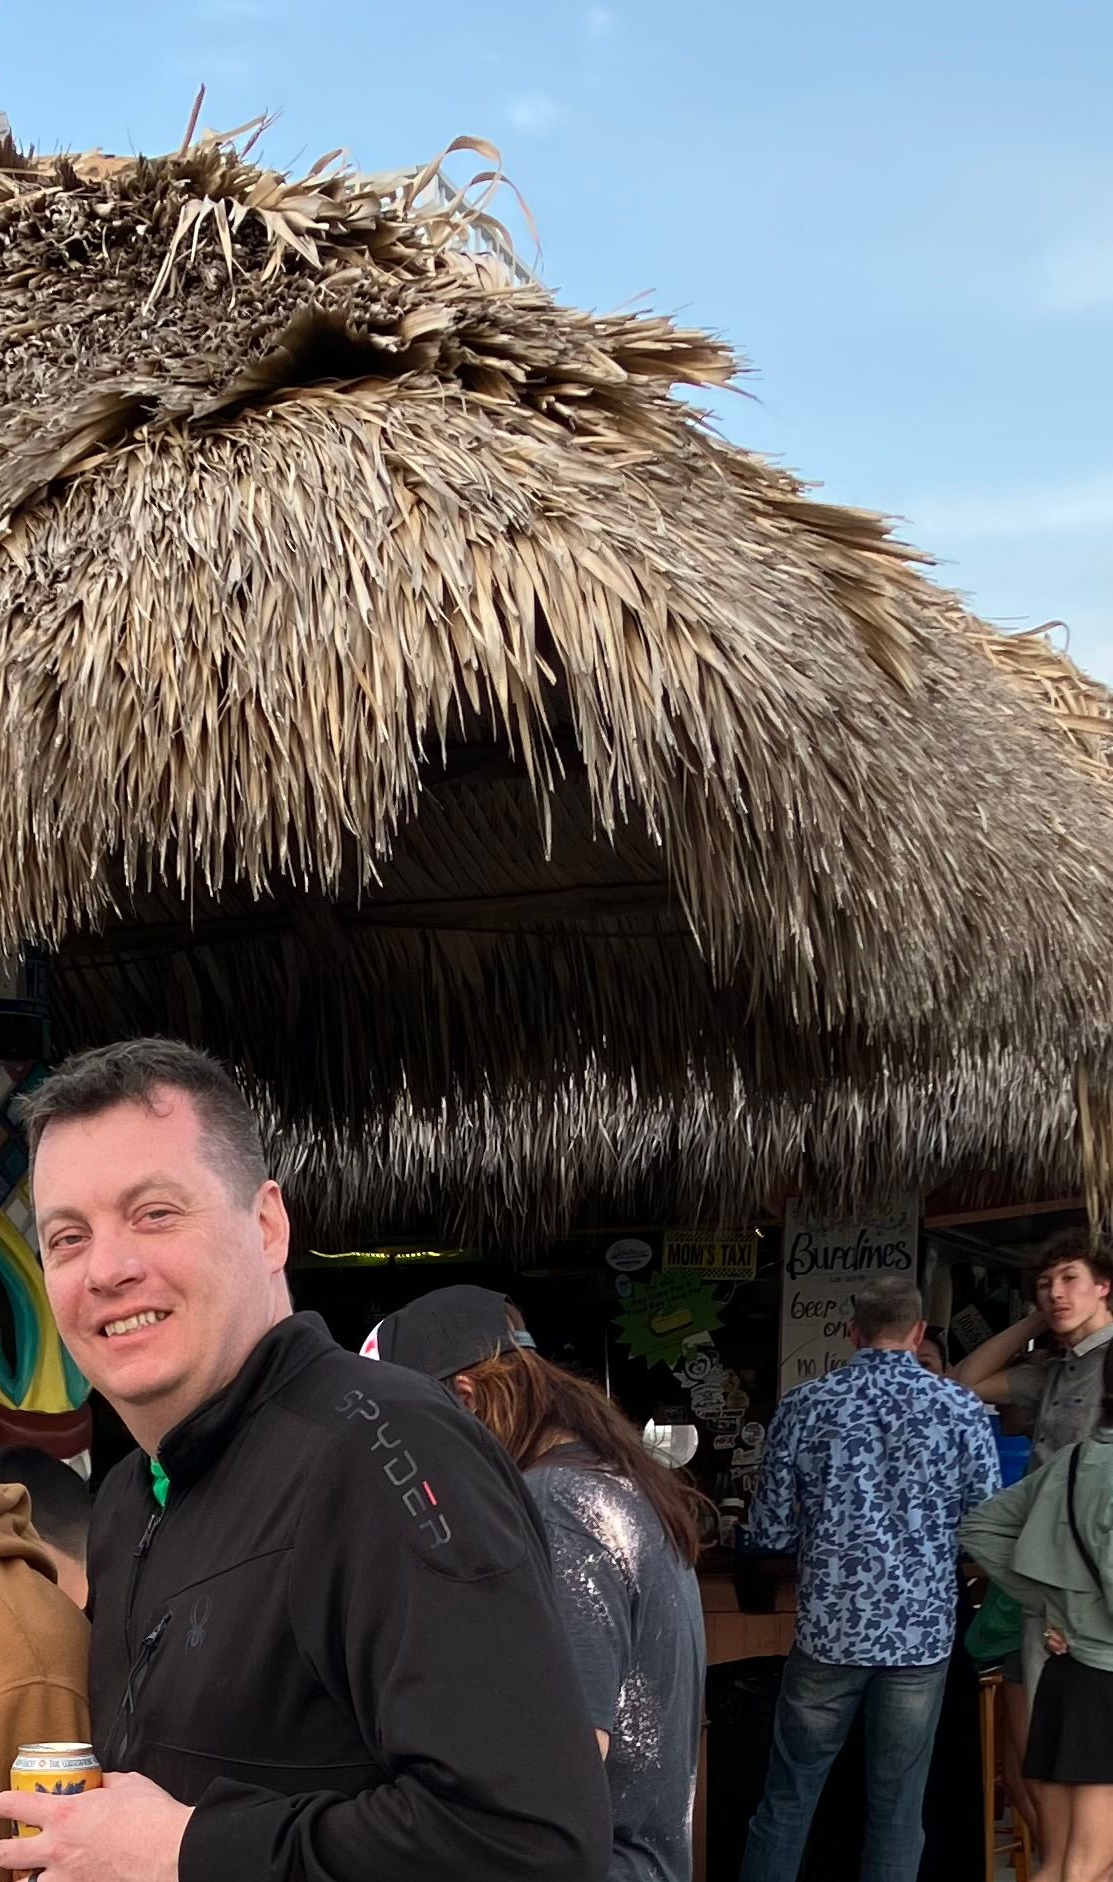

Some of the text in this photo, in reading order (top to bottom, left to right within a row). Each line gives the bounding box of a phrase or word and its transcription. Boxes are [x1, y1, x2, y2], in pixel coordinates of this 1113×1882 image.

[667, 1243, 716, 1266] MOM'S
[721, 1242, 752, 1266] TAXI
[786, 1229, 912, 1280] Burdines
[791, 1291, 837, 1319] beer
[797, 1357, 817, 1377] no
[335, 1389, 453, 1549] SPYDER
